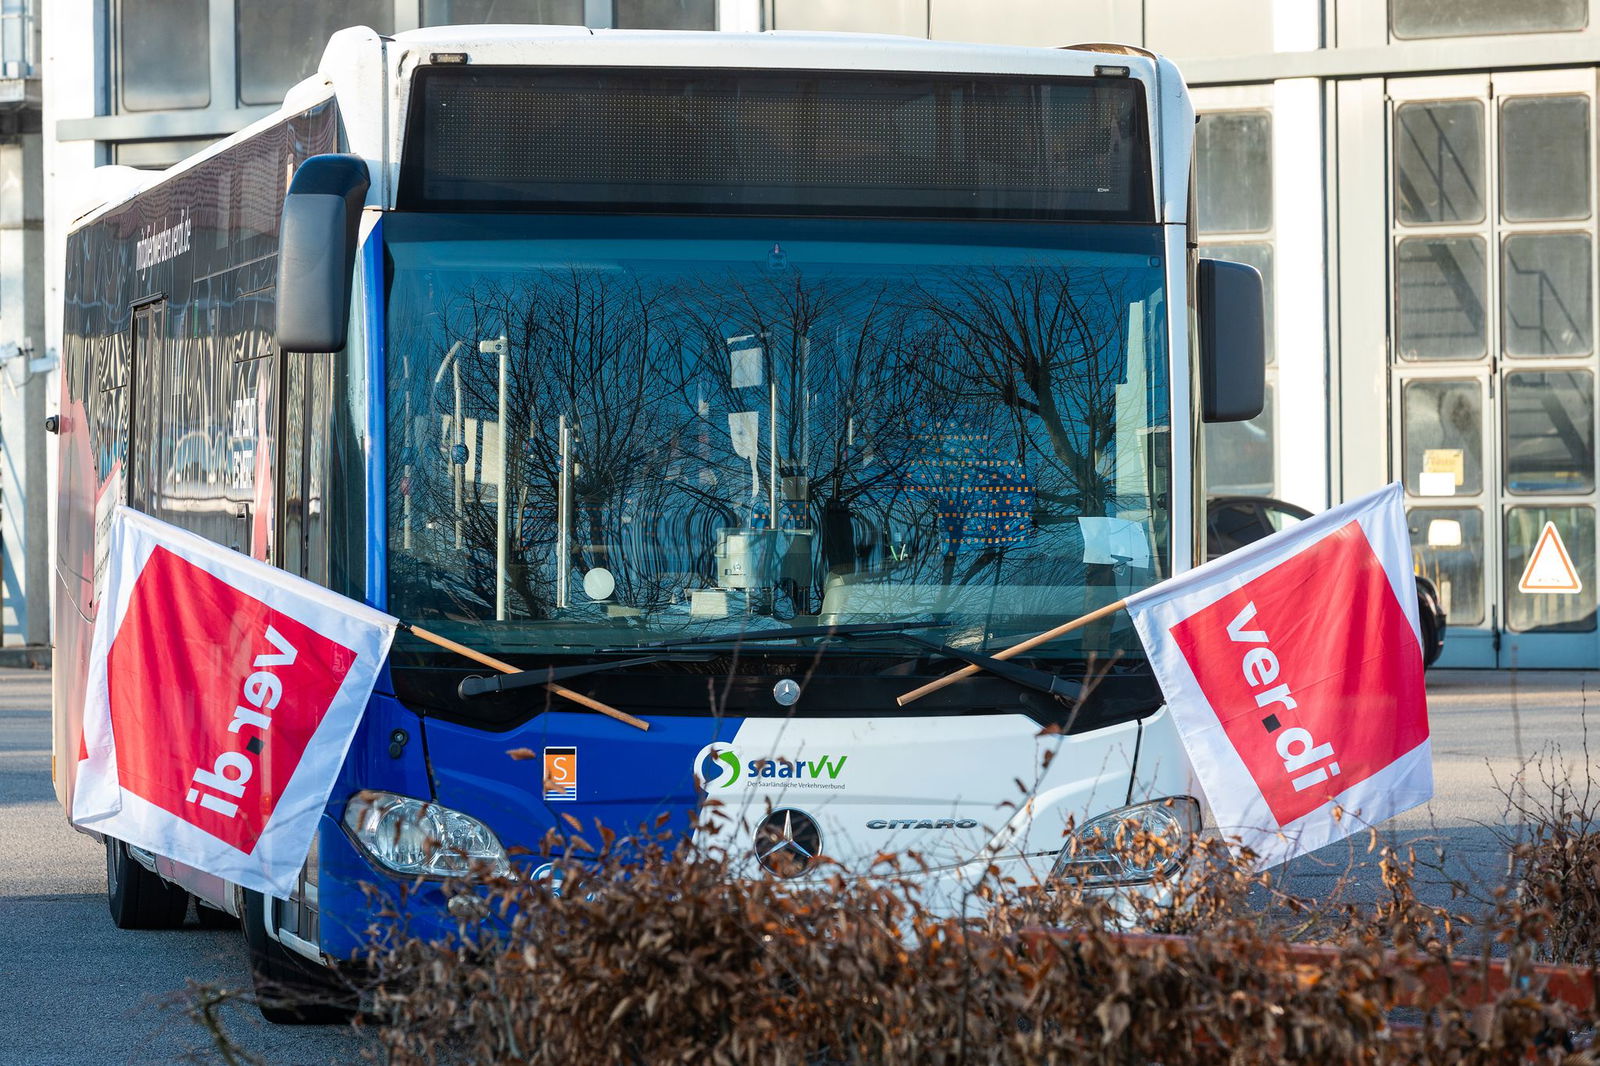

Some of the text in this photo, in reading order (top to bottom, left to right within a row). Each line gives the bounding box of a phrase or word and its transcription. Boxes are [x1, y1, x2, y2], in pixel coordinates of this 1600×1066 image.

[553, 756, 568, 781] S
[798, 782, 846, 790] Verkehrsverbund
[866, 818, 978, 830] CITARO
